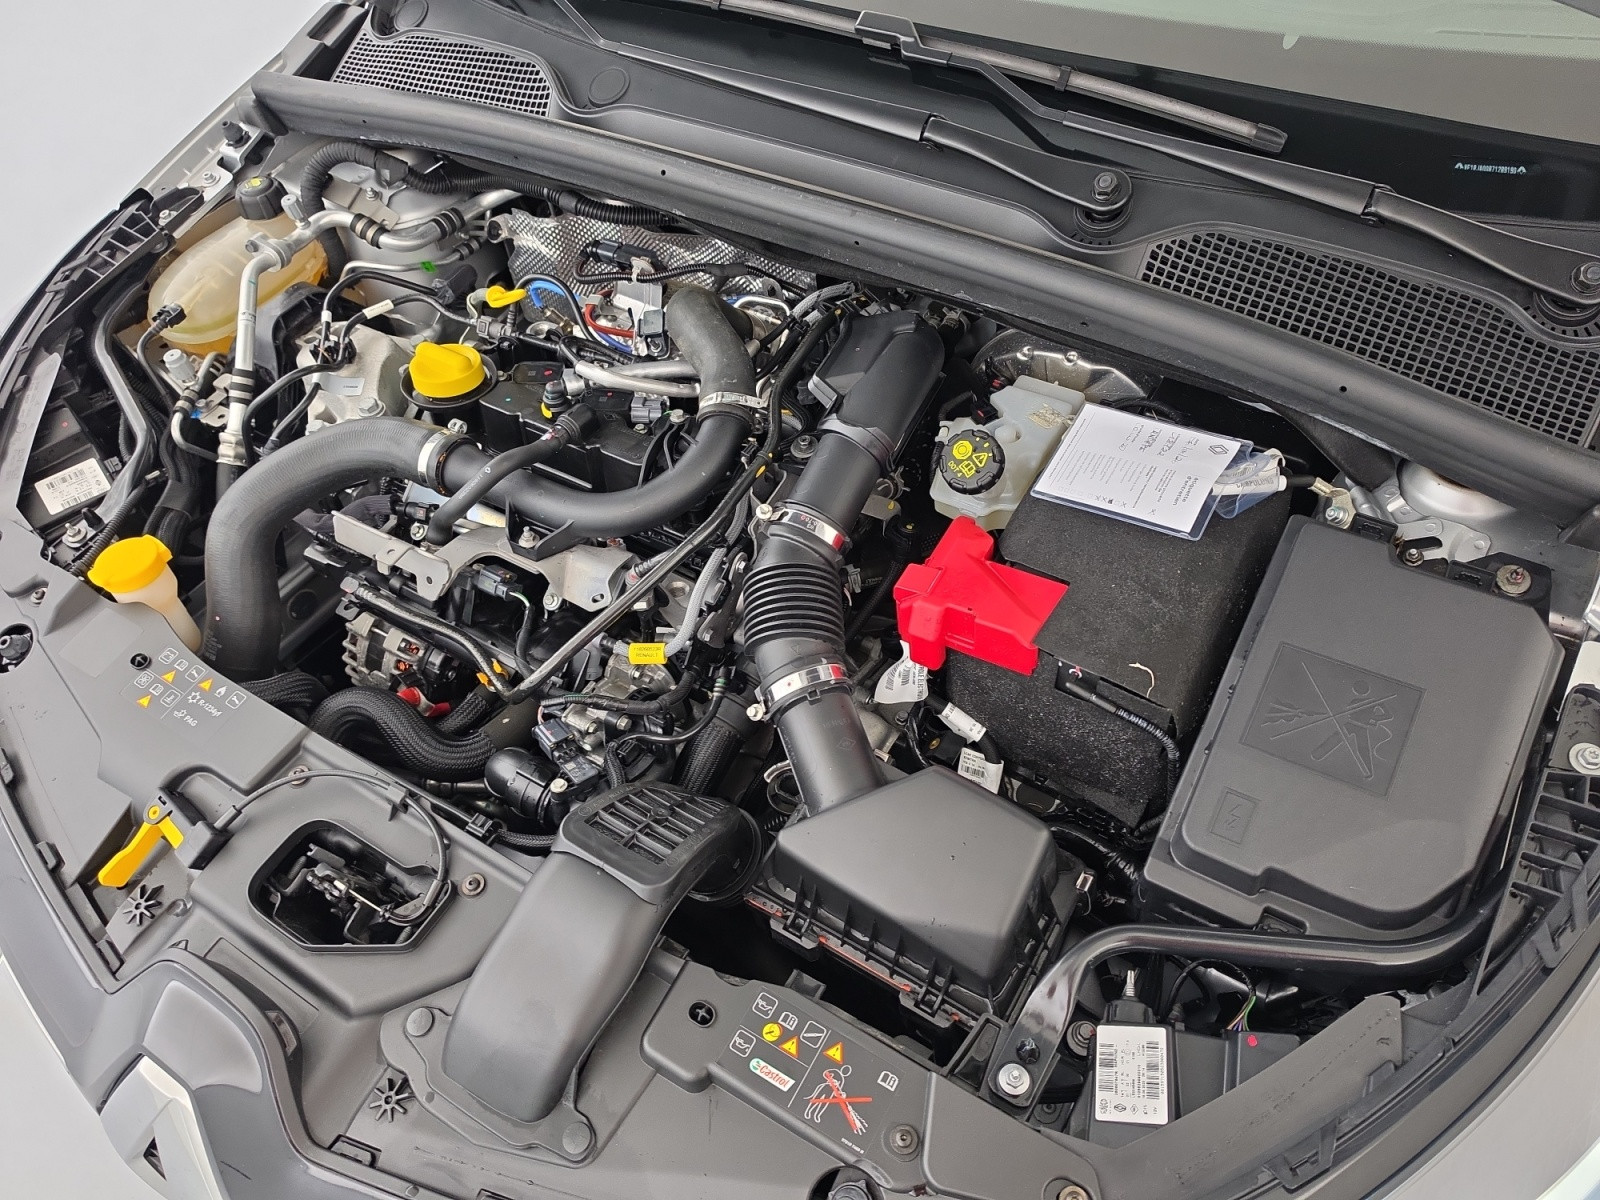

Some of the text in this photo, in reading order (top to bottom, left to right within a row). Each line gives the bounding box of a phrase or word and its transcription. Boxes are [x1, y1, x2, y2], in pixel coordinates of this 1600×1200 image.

[946, 459, 960, 473] DOT
[182, 713, 198, 727] PAG
[758, 1063, 790, 1088] Castrol
